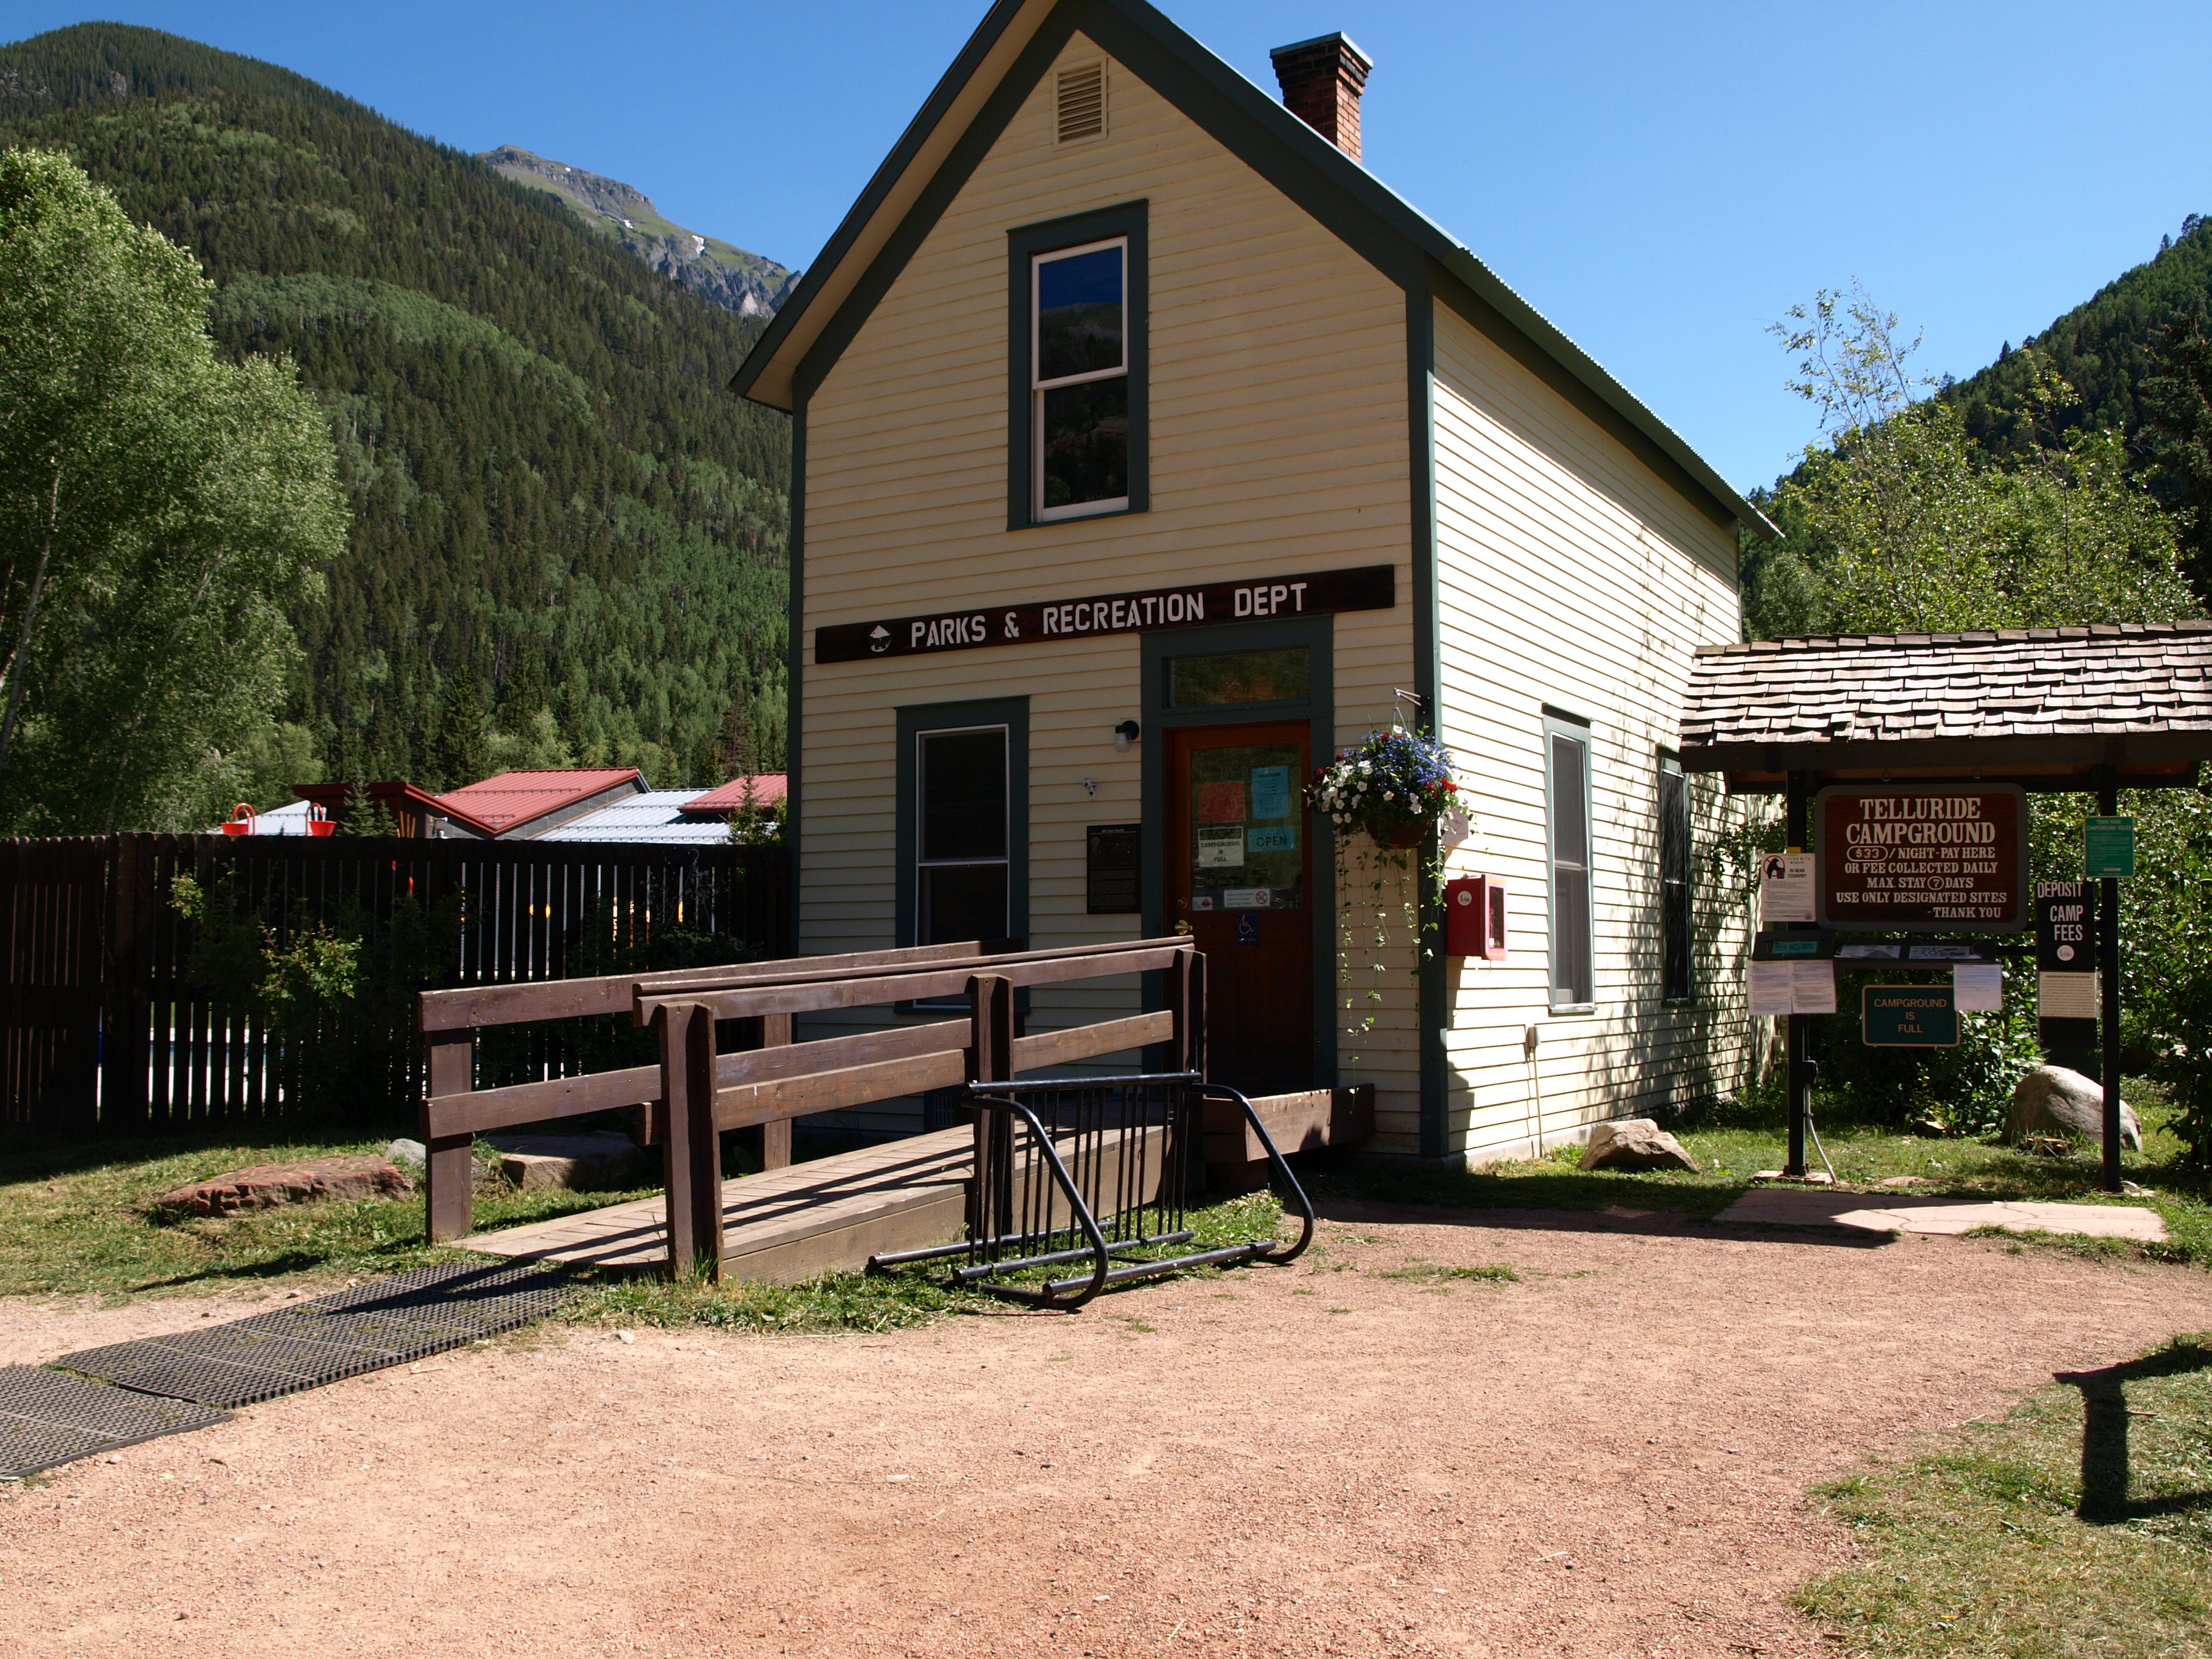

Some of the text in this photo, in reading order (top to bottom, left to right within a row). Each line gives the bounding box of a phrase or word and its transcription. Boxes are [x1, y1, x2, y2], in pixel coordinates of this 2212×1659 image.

[911, 582, 1308, 648] PARKS & RECREATION DEPT
[1860, 797, 1981, 820] TELLURIDE
[1846, 822, 1996, 845] CAMPGROUND
[1256, 835, 1287, 847] OPEN
[1855, 848, 1880, 859] $33
[1962, 846, 1996, 859] HERE
[1844, 862, 1999, 874] OR FEE COLLECTED DAILY
[1898, 877, 1927, 889] STAY
[1944, 877, 1974, 889] DAYS
[2037, 881, 2083, 899] DEPOSIT
[1836, 891, 2007, 903] USE ONLY DESIGNATED SITES
[1978, 907, 2002, 919] YOU
[2049, 905, 2084, 922] CAMP
[2054, 924, 2083, 942] FEES
[1873, 998, 1948, 1008] CAMPGROUND
[1905, 1011, 1915, 1021] IS
[1898, 1024, 1923, 1033] FULL
